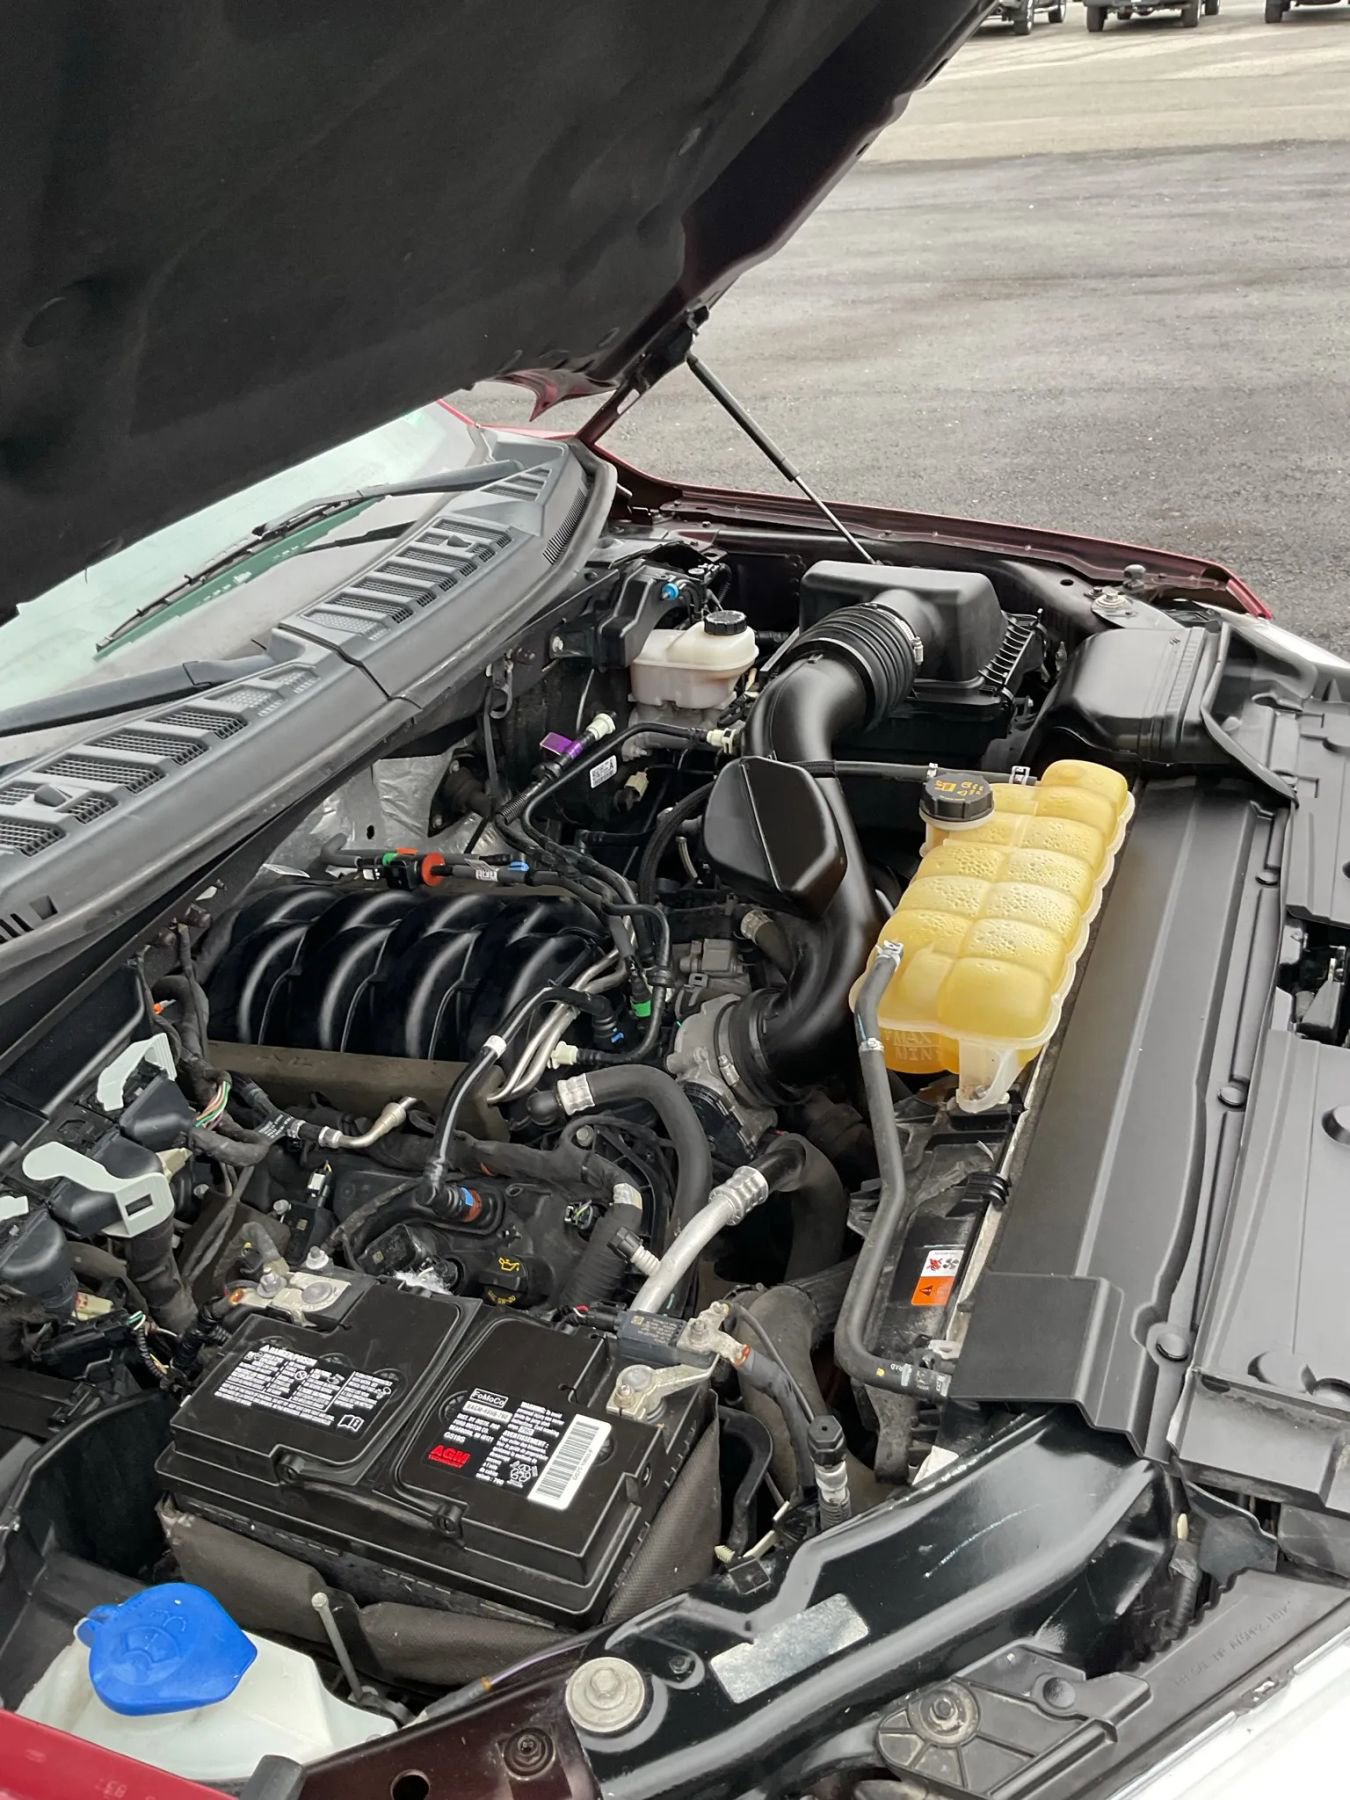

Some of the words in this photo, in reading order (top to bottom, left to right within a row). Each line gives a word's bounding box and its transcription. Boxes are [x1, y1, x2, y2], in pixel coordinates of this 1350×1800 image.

[895, 1046, 932, 1061] MIN
[471, 1389, 506, 1406] FoMoCo
[430, 1444, 471, 1464] AGM
